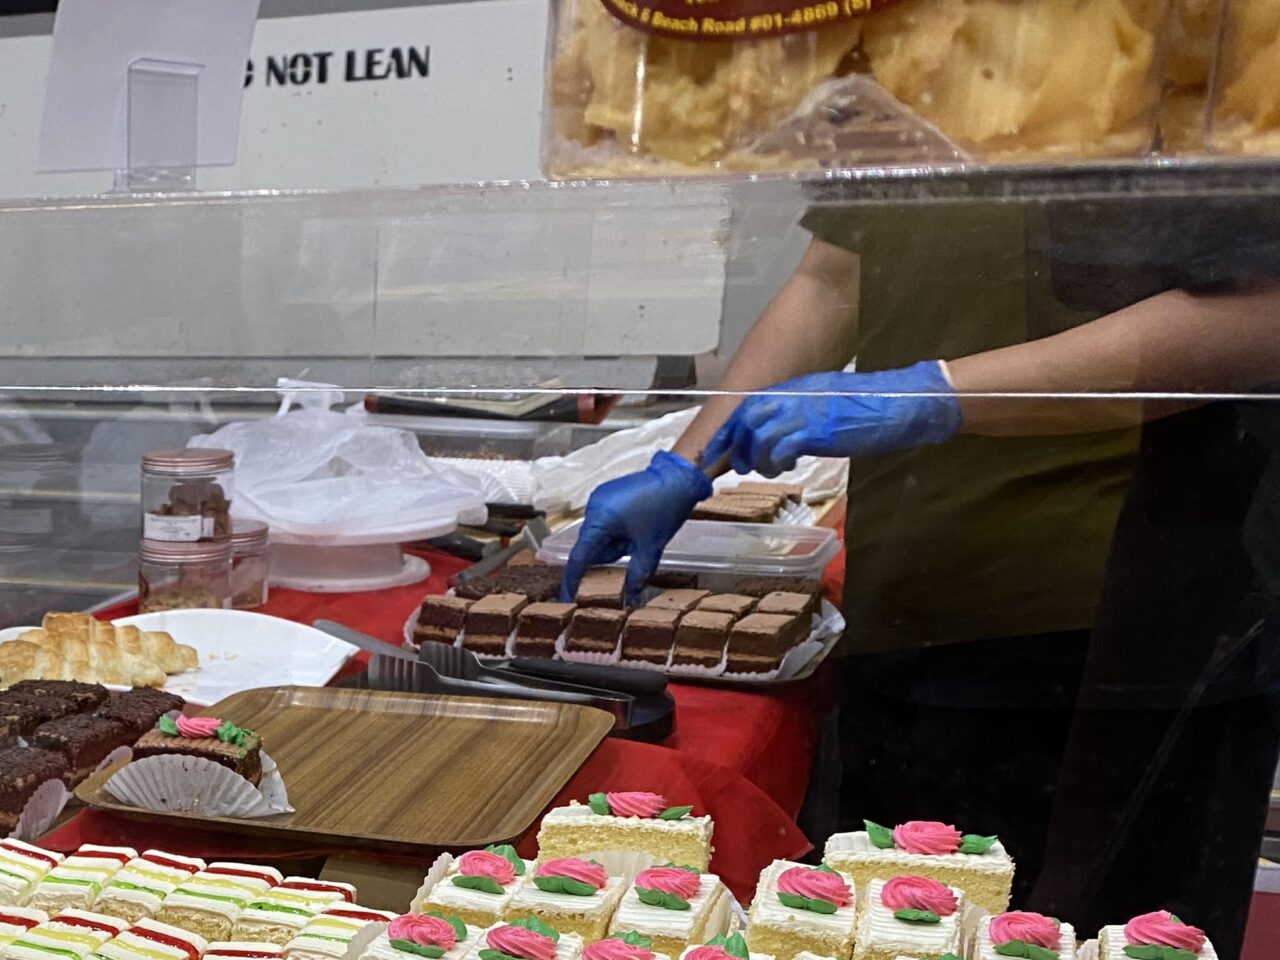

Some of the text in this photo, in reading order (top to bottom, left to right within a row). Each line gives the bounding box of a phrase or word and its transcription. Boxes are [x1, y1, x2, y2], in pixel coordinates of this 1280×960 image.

[701, 16, 746, 34] Road
[266, 52, 334, 87] NOT
[343, 45, 431, 82] LEAN
